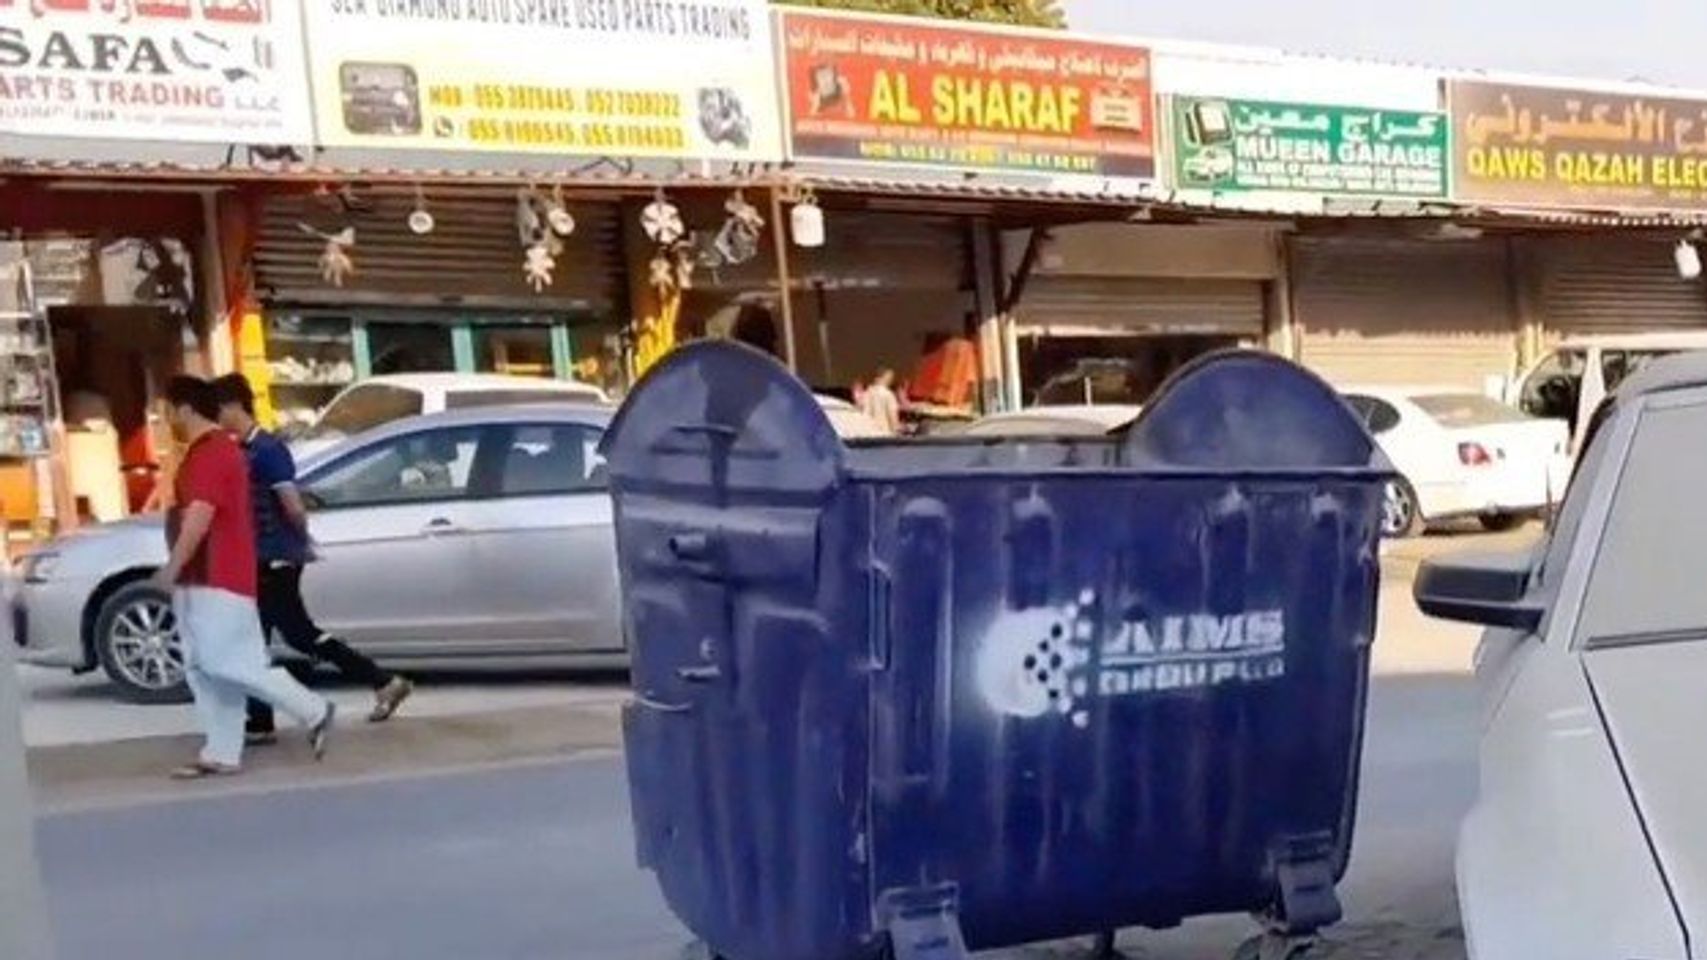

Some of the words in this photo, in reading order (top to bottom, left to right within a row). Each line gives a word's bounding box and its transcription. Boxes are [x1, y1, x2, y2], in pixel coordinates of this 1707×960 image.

[467, 0, 511, 24] AUTO
[515, 0, 571, 28] SPARE
[577, 0, 619, 32] USED
[624, 1, 676, 35] PARTS
[679, 3, 751, 40] TRADING
[90, 80, 225, 108] TRADING
[870, 69, 923, 124] AL
[931, 73, 1081, 133] SHARAF
[1341, 112, 1438, 141] كراج
[1236, 136, 1331, 163] MUEEN
[1337, 140, 1443, 168] GARAGE
[1467, 147, 1546, 180] QAWS
[1555, 151, 1644, 186] QAZAH
[1100, 610, 1285, 654] AIMS
